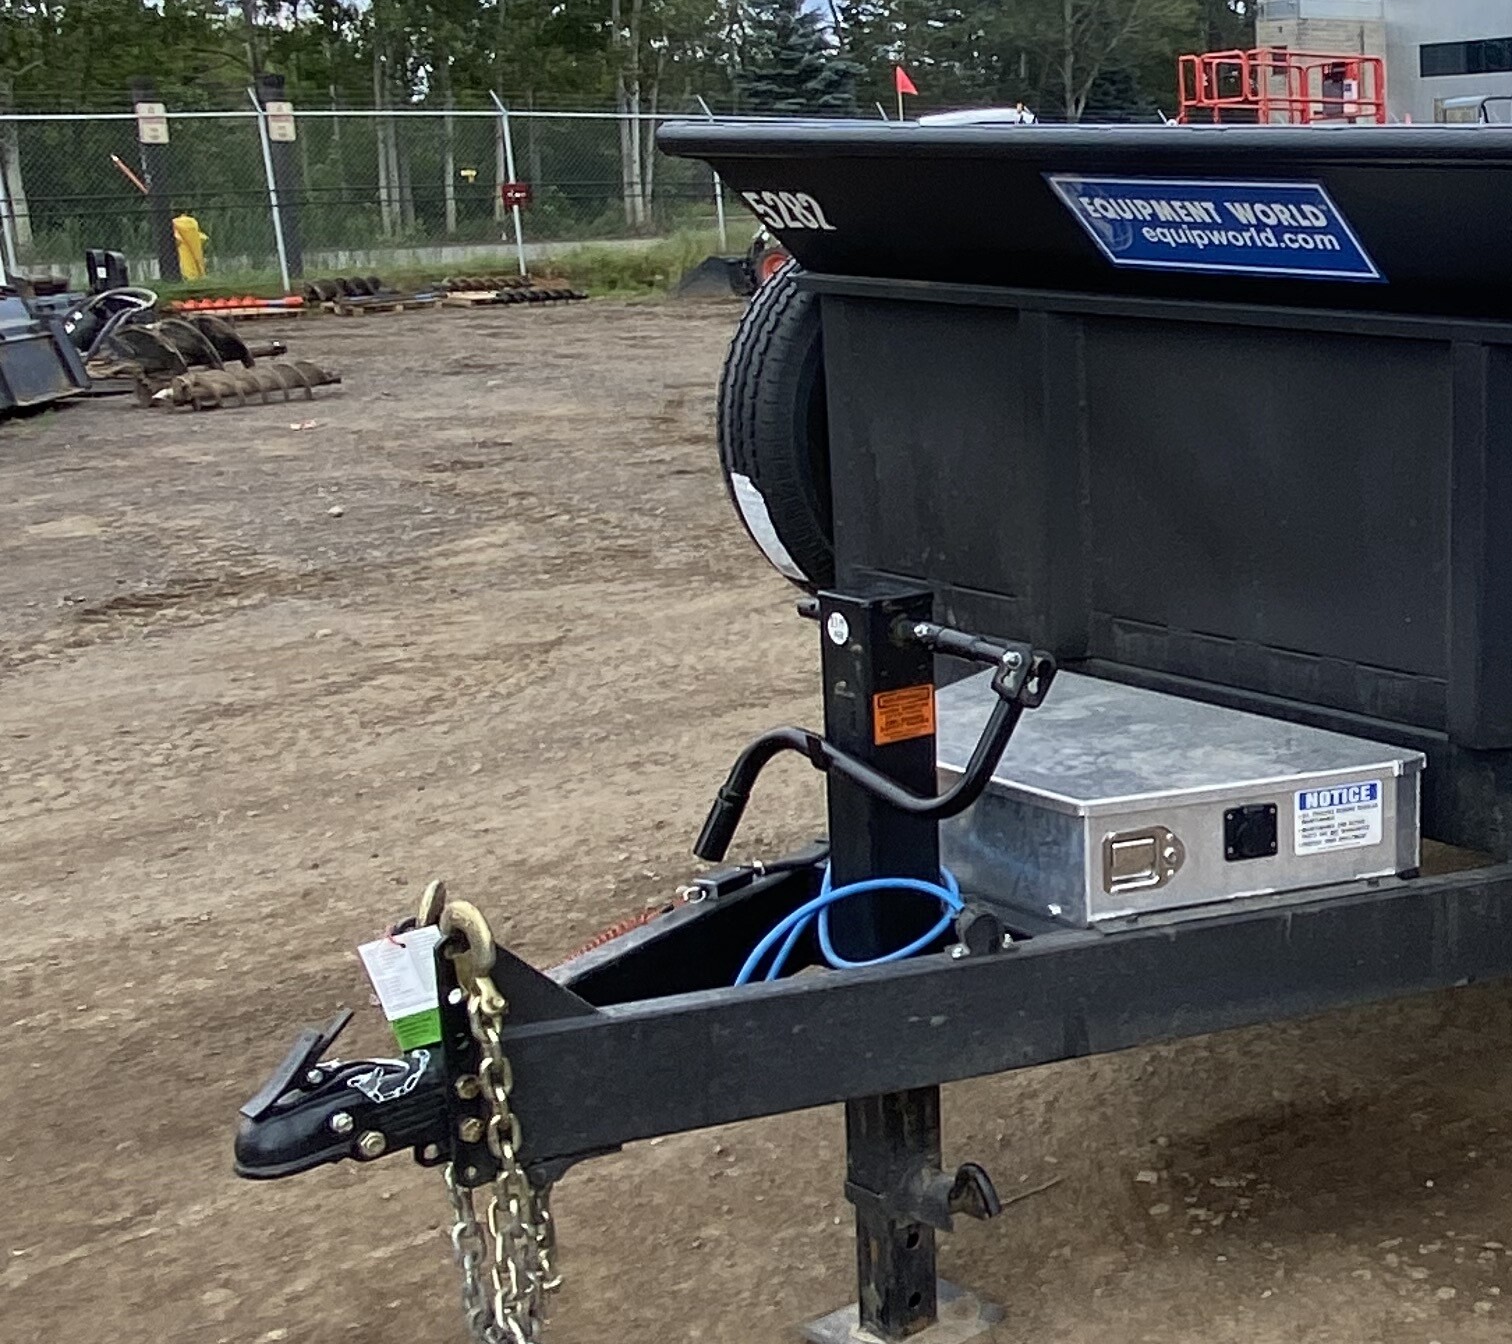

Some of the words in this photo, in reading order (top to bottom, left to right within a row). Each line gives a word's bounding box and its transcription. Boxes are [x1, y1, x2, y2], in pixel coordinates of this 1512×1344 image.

[741, 191, 837, 230] 5282
[1079, 196, 1221, 224] EQUIPMENT
[1224, 201, 1328, 228] WORLD
[1142, 224, 1341, 251] equipworld.com
[1305, 785, 1371, 809] NOTICE
